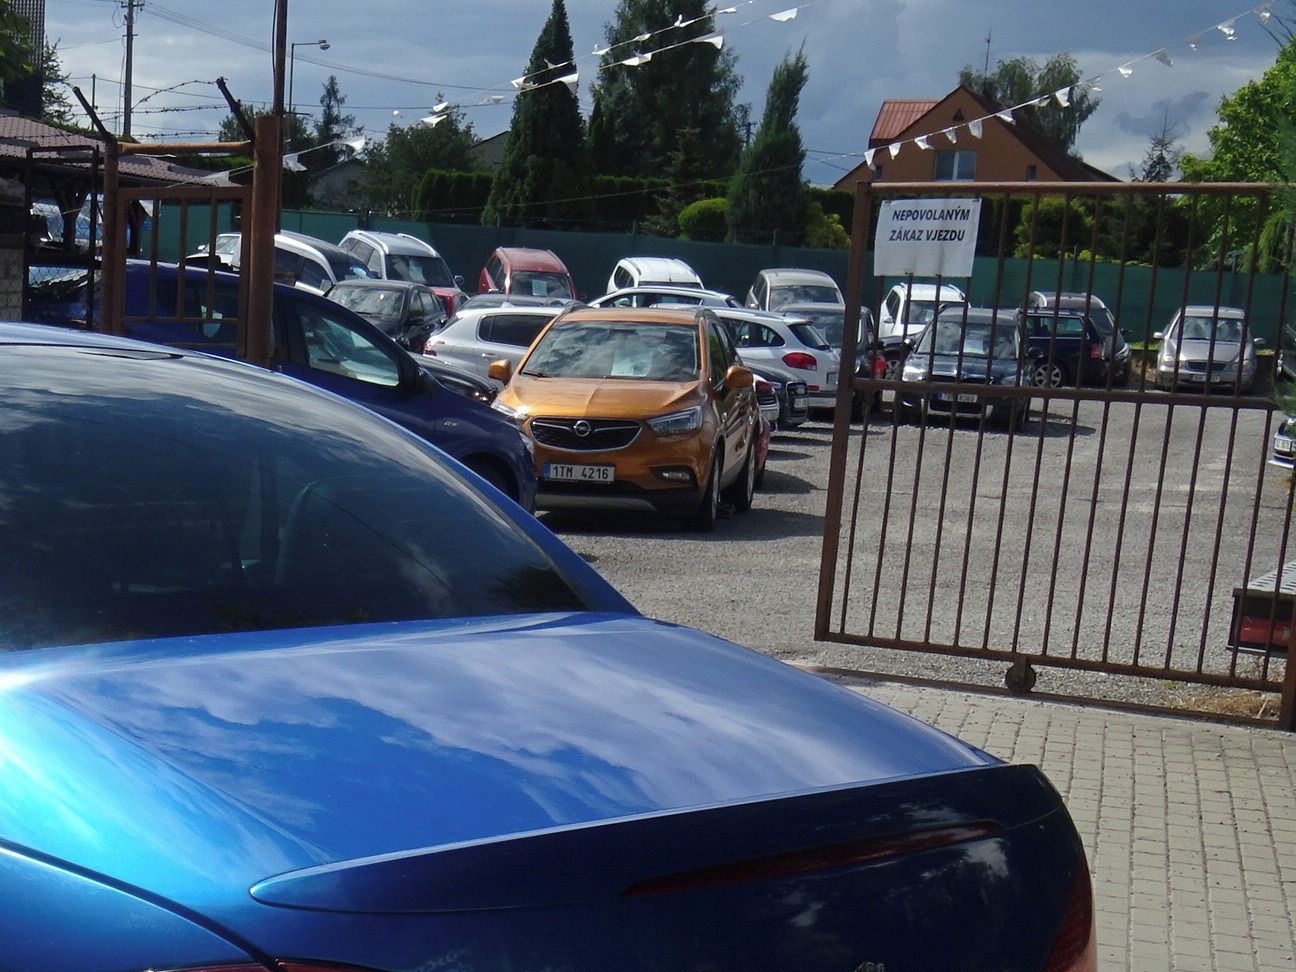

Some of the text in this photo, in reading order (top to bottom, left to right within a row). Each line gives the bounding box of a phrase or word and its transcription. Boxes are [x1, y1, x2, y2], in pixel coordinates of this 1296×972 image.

[892, 206, 971, 222] NEPOVOLANÝM
[889, 228, 966, 242] ZÁKAZ VJEZDU
[553, 465, 609, 480] 1TM 4216
